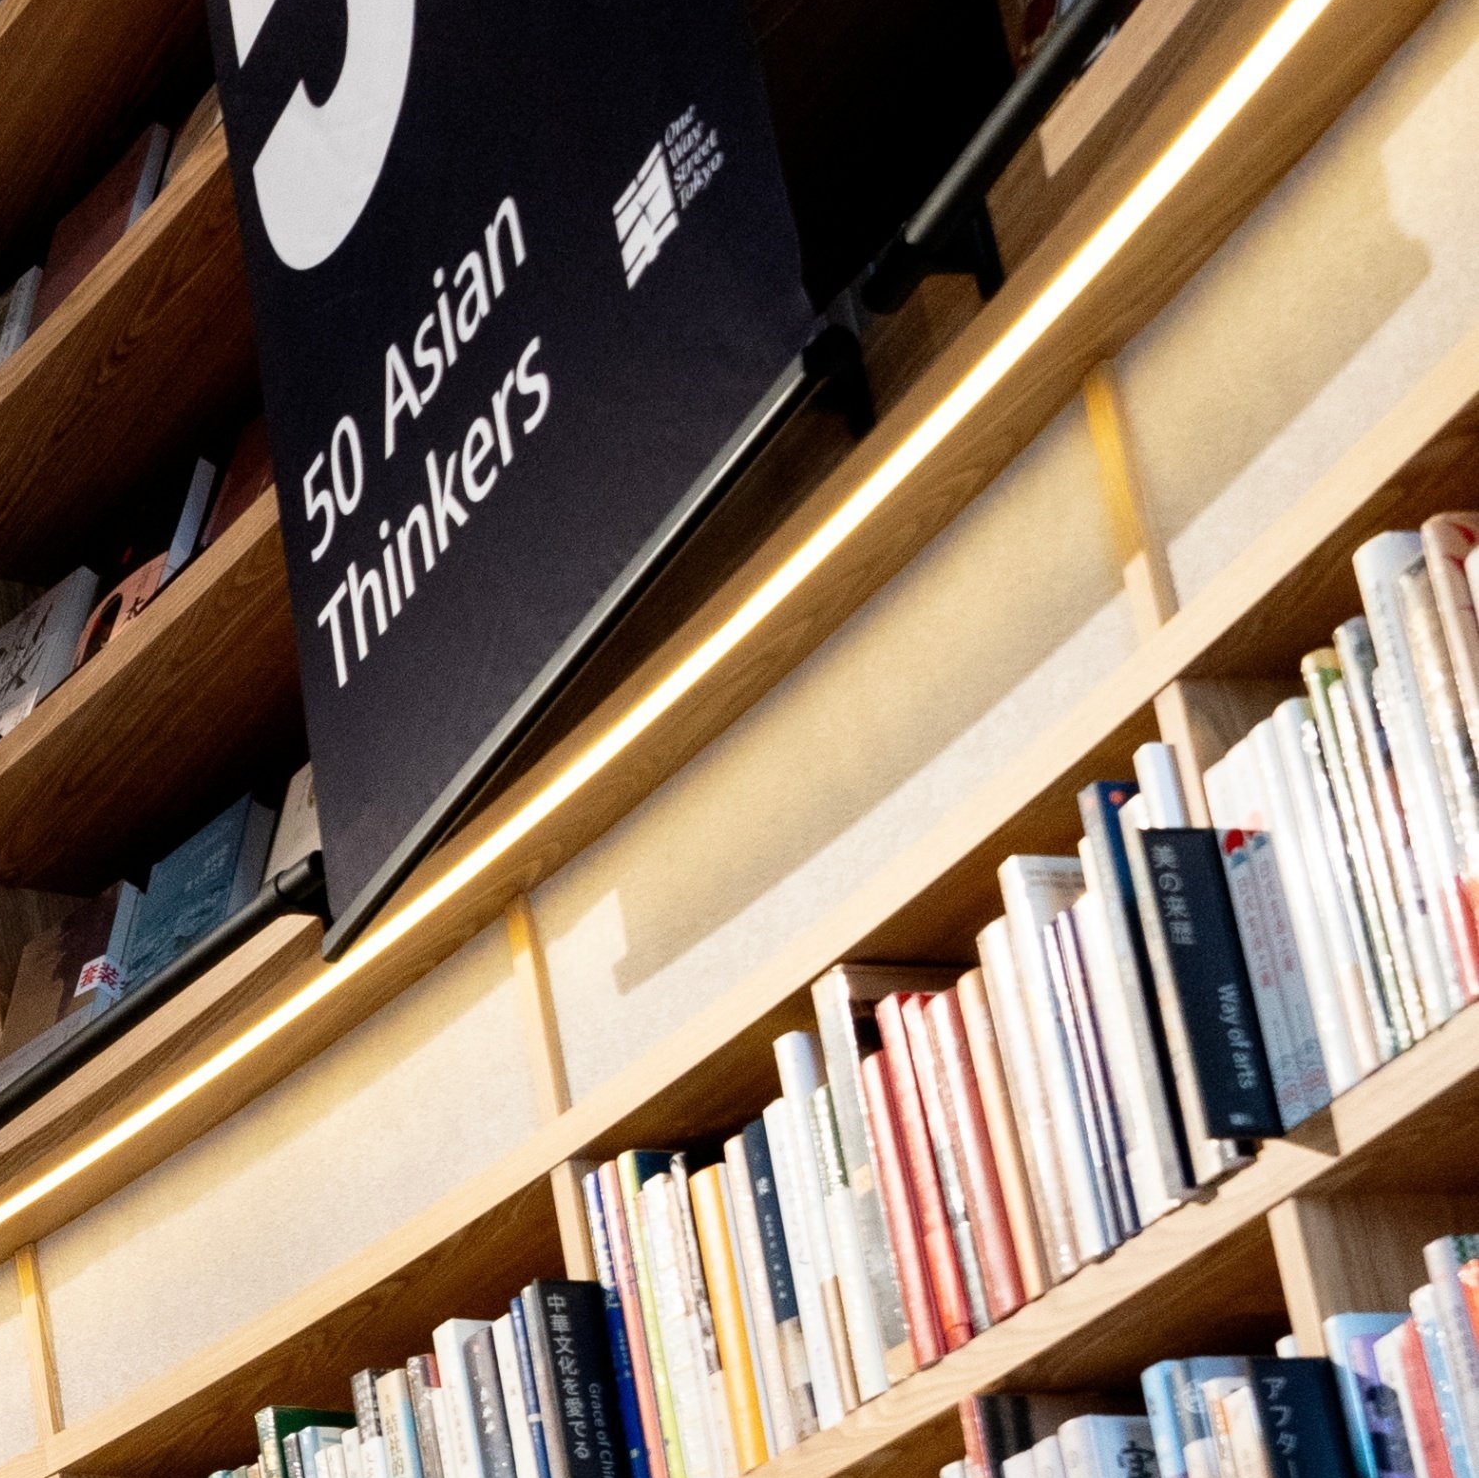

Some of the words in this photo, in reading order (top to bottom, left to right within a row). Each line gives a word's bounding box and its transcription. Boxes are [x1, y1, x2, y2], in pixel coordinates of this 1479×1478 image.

[665, 104, 696, 146] One
[669, 122, 703, 167] Way
[674, 128, 718, 190] Street
[677, 151, 724, 210] Tokyo
[299, 413, 366, 562] 50
[381, 193, 527, 472] Asian
[316, 338, 552, 689] Thinkers
[1216, 982, 1239, 1020] Way
[1231, 1049, 1260, 1091] arts
[545, 1292, 590, 1461] 中華文化を愛でる
[587, 1382, 607, 1431] Grace
